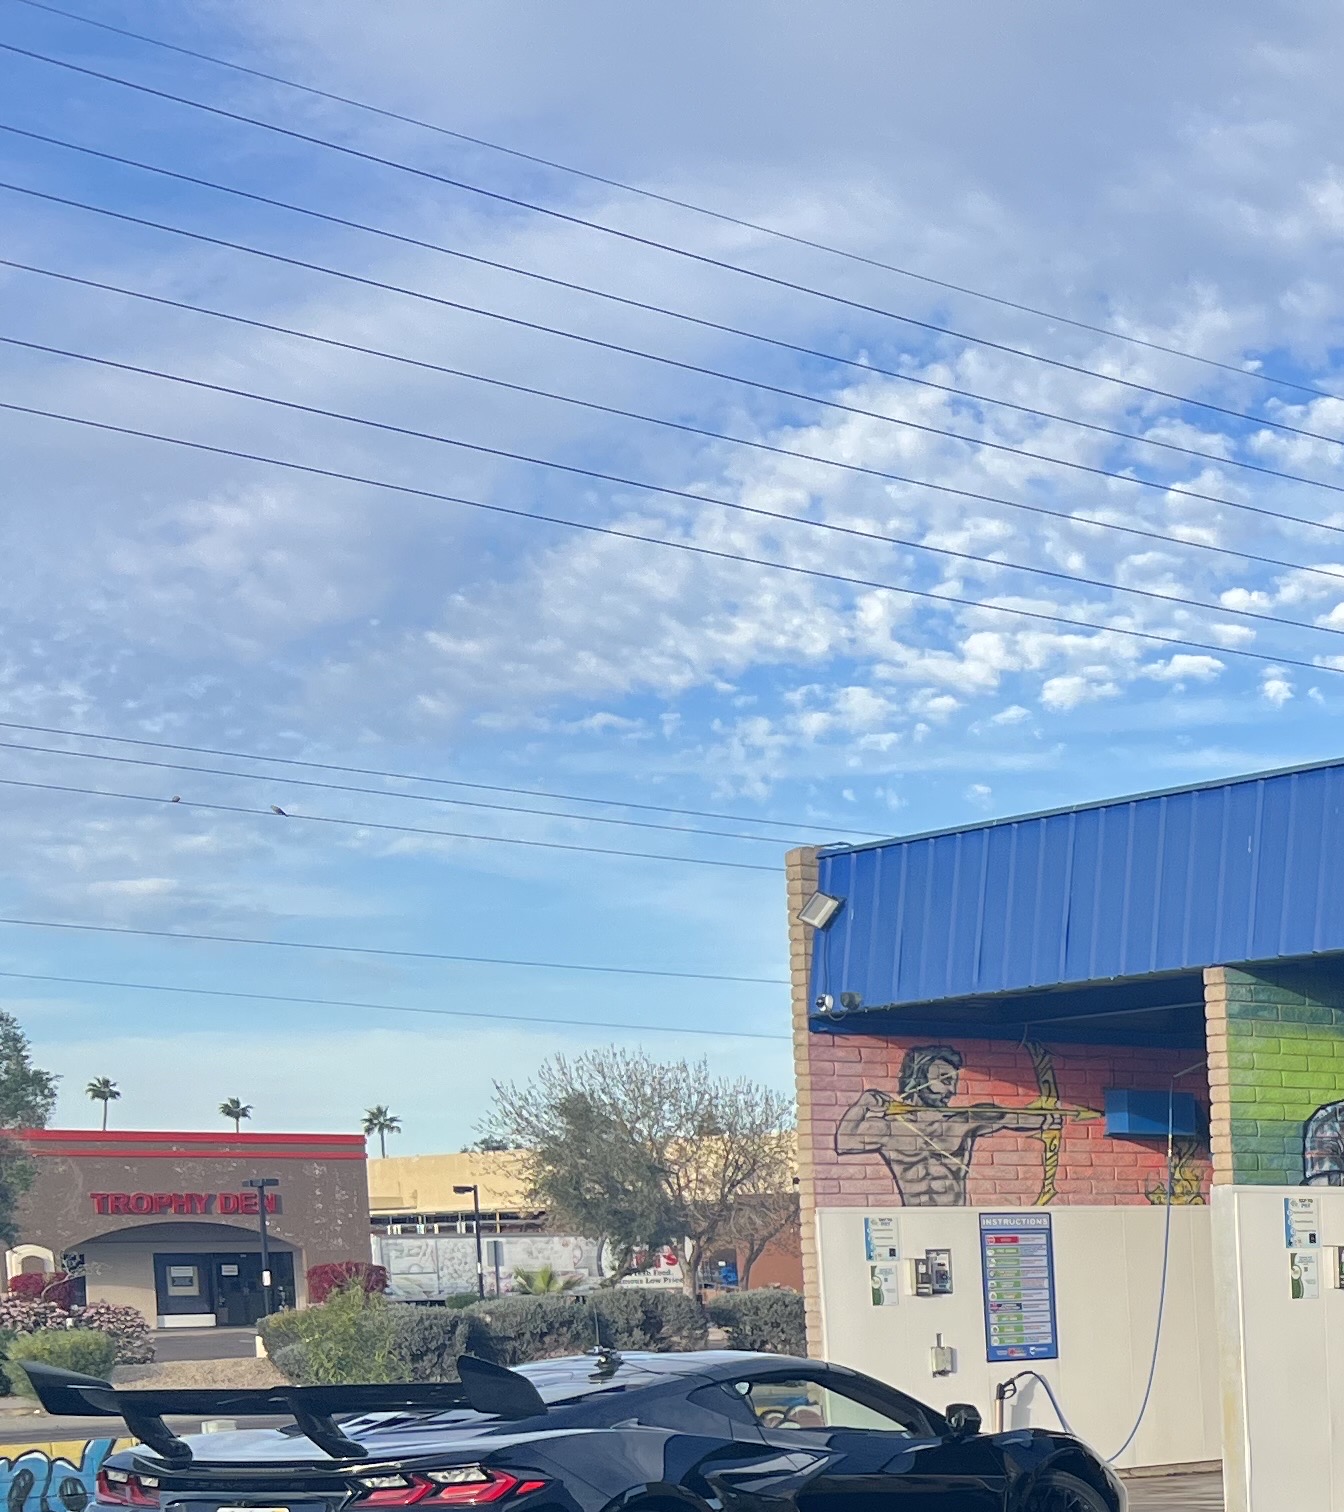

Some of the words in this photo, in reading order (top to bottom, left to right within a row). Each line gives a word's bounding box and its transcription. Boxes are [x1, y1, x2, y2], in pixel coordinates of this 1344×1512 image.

[89, 1192, 211, 1215] TROPHY
[216, 1192, 278, 1215] DEN
[982, 1217, 1048, 1226] INSTRUCTIONS
